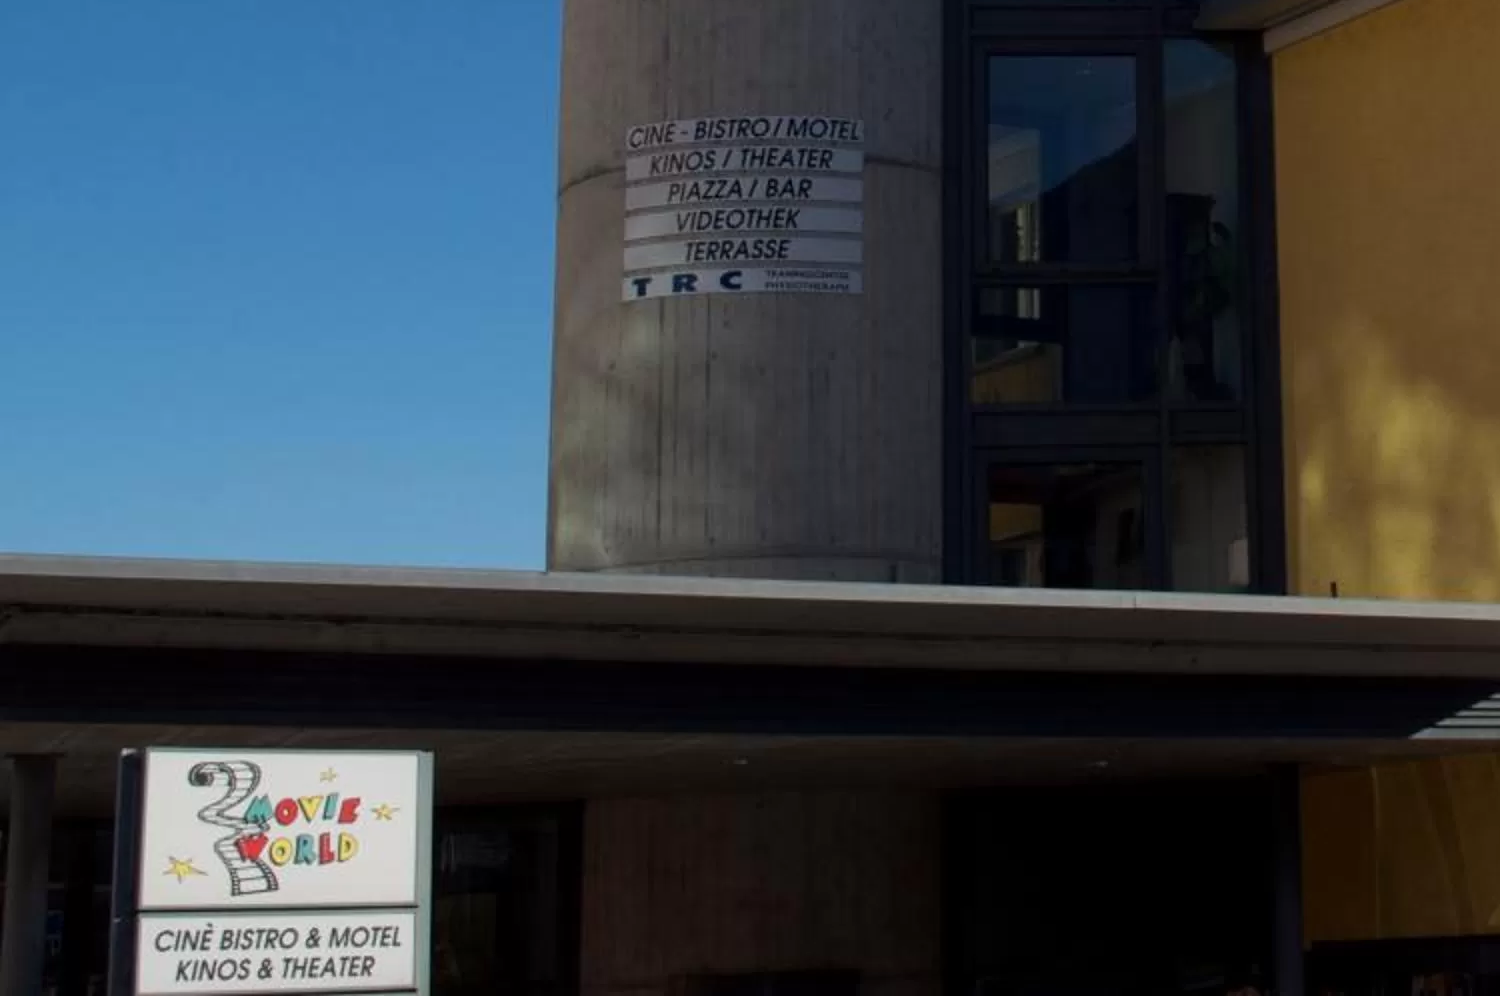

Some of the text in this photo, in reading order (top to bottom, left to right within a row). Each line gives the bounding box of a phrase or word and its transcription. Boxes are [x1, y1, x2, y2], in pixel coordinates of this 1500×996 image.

[651, 151, 716, 175] KINOS
[741, 148, 834, 170] THEATER
[667, 179, 743, 203] PIAZZA
[766, 177, 813, 199] BAR
[676, 208, 800, 232] VIDEOTHEK
[685, 239, 792, 262] TERRASSE
[243, 792, 361, 826] MOVIE
[233, 832, 359, 867] WORLD
[219, 927, 299, 951] BISTRO
[305, 927, 322, 948] &
[328, 925, 402, 948] MOTEL
[175, 955, 376, 983] KINOS & THEATER
